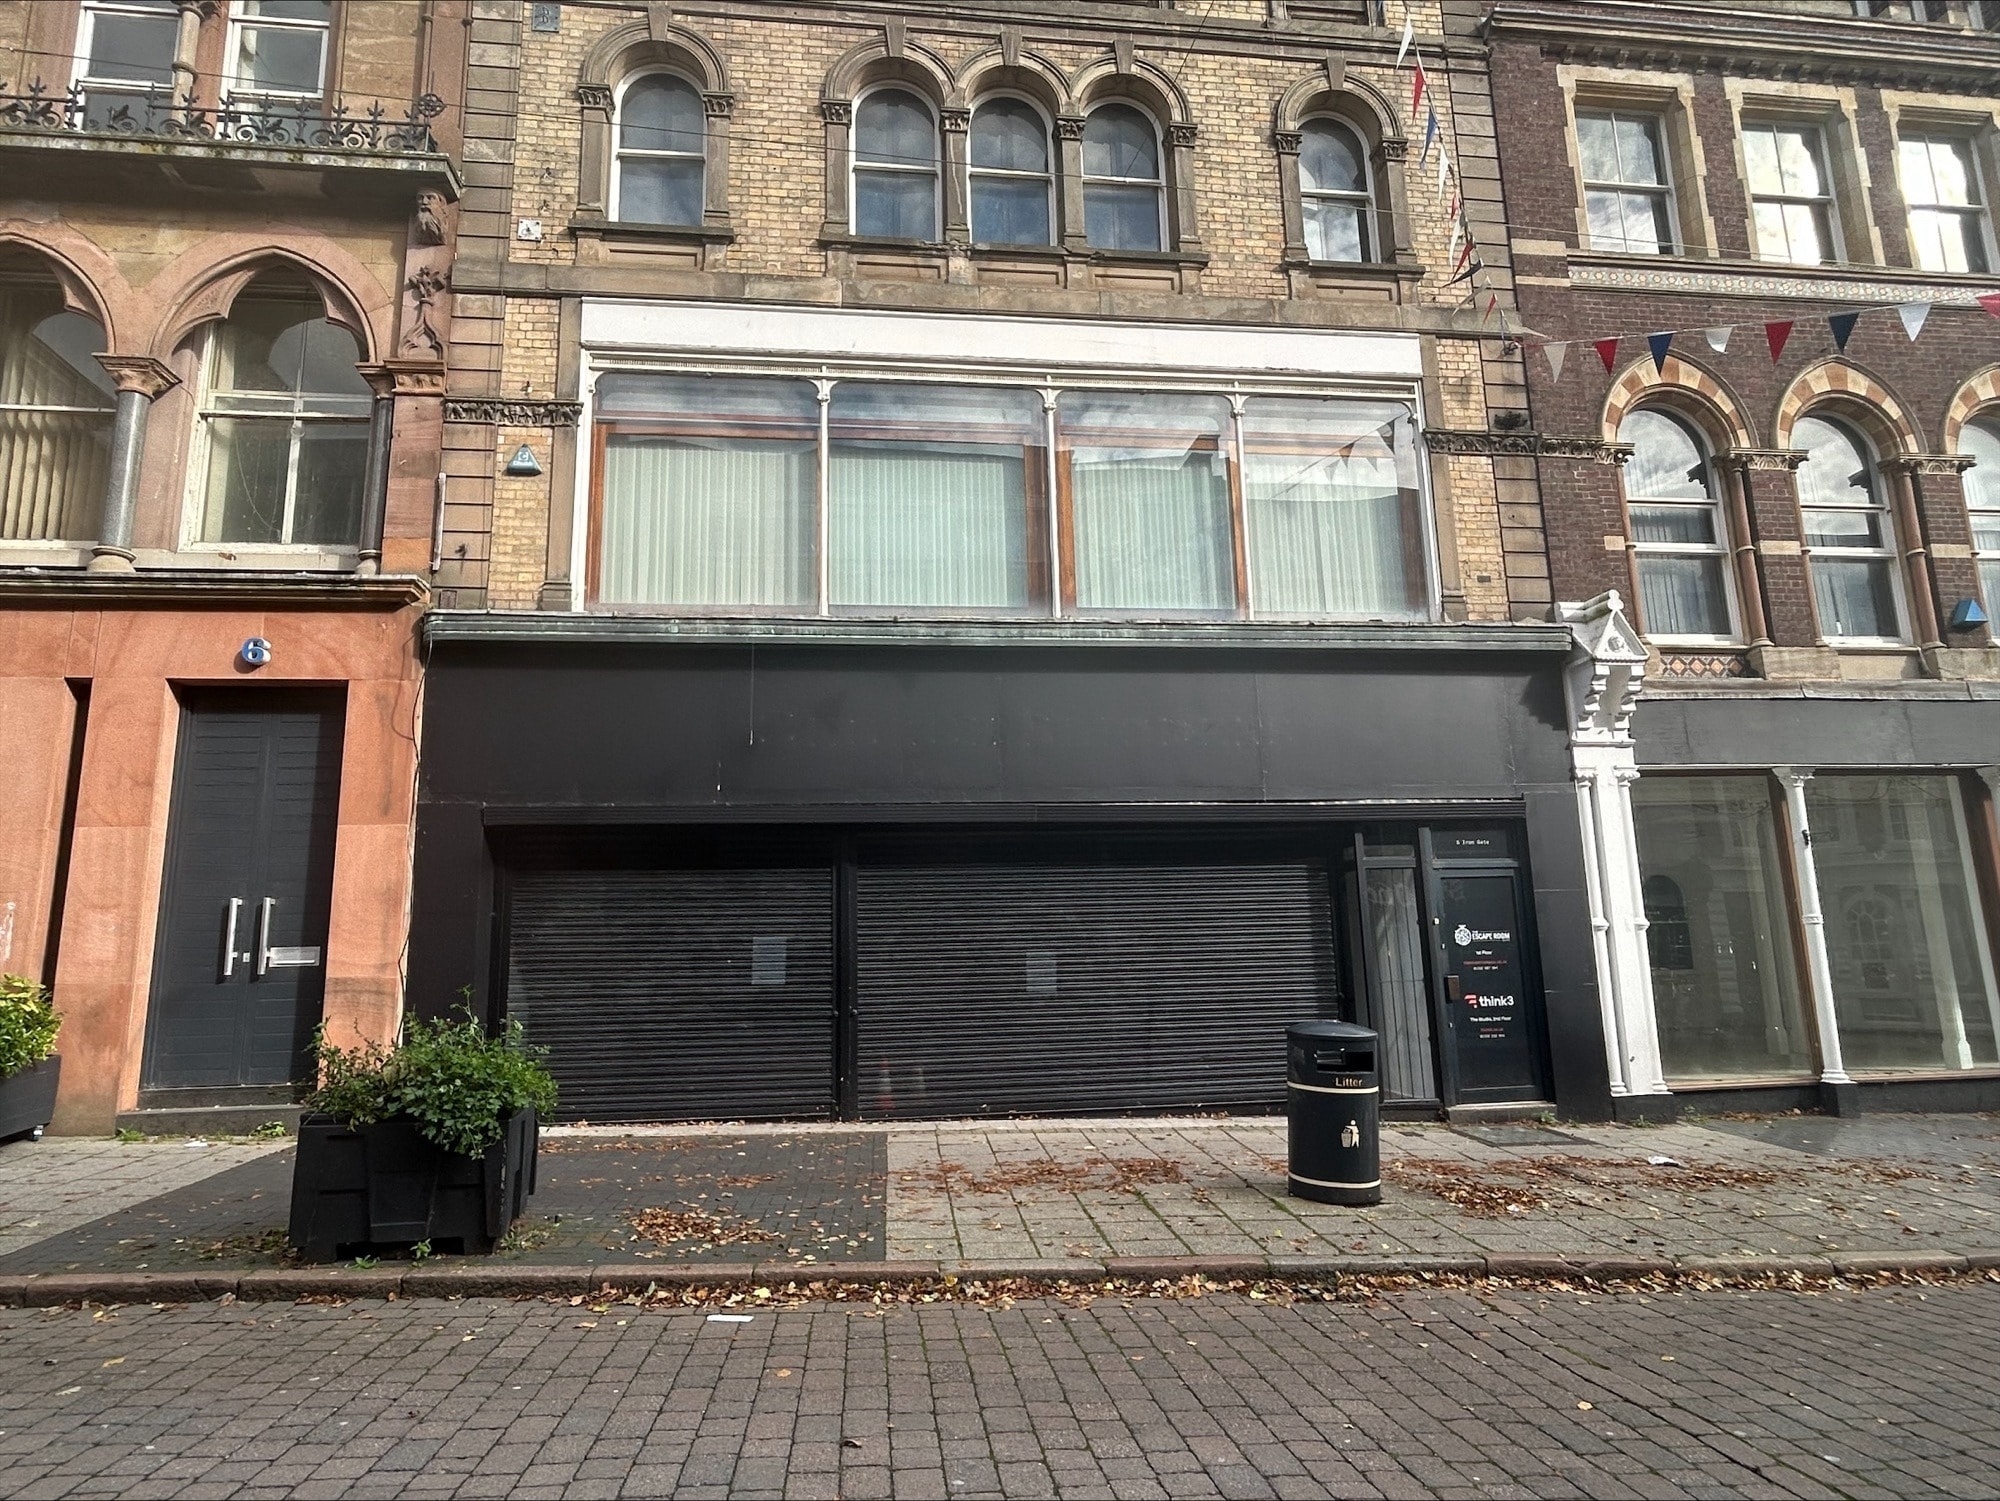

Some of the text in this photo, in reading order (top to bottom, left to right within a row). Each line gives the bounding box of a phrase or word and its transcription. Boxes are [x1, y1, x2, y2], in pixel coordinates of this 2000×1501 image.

[242, 637, 271, 665] 6
[1471, 932, 1493, 940] ESCAPE
[1493, 932, 1510, 940] ROOM
[1479, 995, 1515, 1007] think3
[1335, 1077, 1363, 1087] Litter
